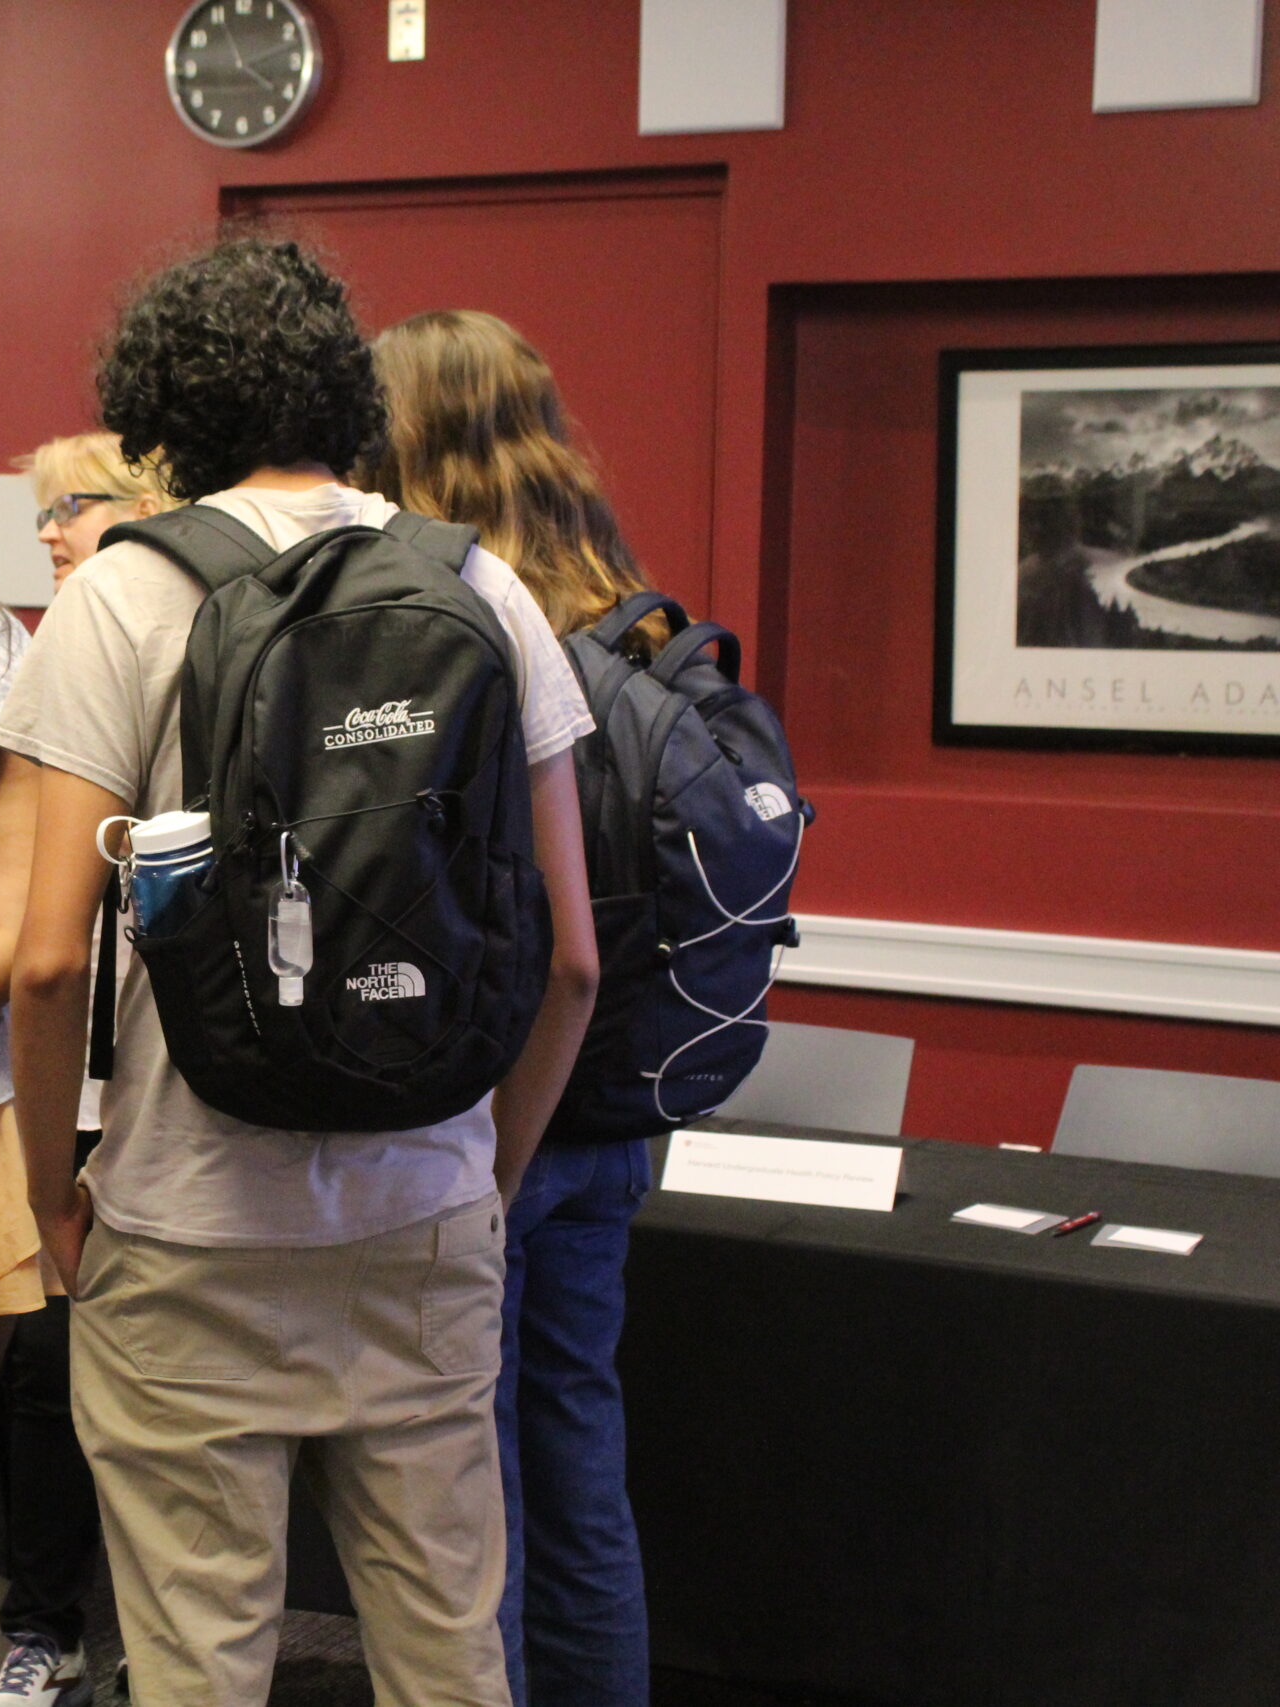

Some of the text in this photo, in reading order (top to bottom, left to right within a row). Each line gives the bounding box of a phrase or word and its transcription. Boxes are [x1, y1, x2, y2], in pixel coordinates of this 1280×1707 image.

[210, 5, 225, 24] 11
[266, 2, 274, 19] 1
[190, 29, 207, 48] 10
[282, 22, 295, 41] 2
[282, 83, 294, 101] 4
[210, 109, 222, 128] 7
[1013, 677, 1154, 703] ANSEL
[344, 699, 412, 732] Coca-Cola
[324, 719, 435, 746] CONSOLIDATED
[367, 962, 398, 976] THE
[346, 974, 398, 990] NORTH
[360, 987, 399, 1002] FACE
